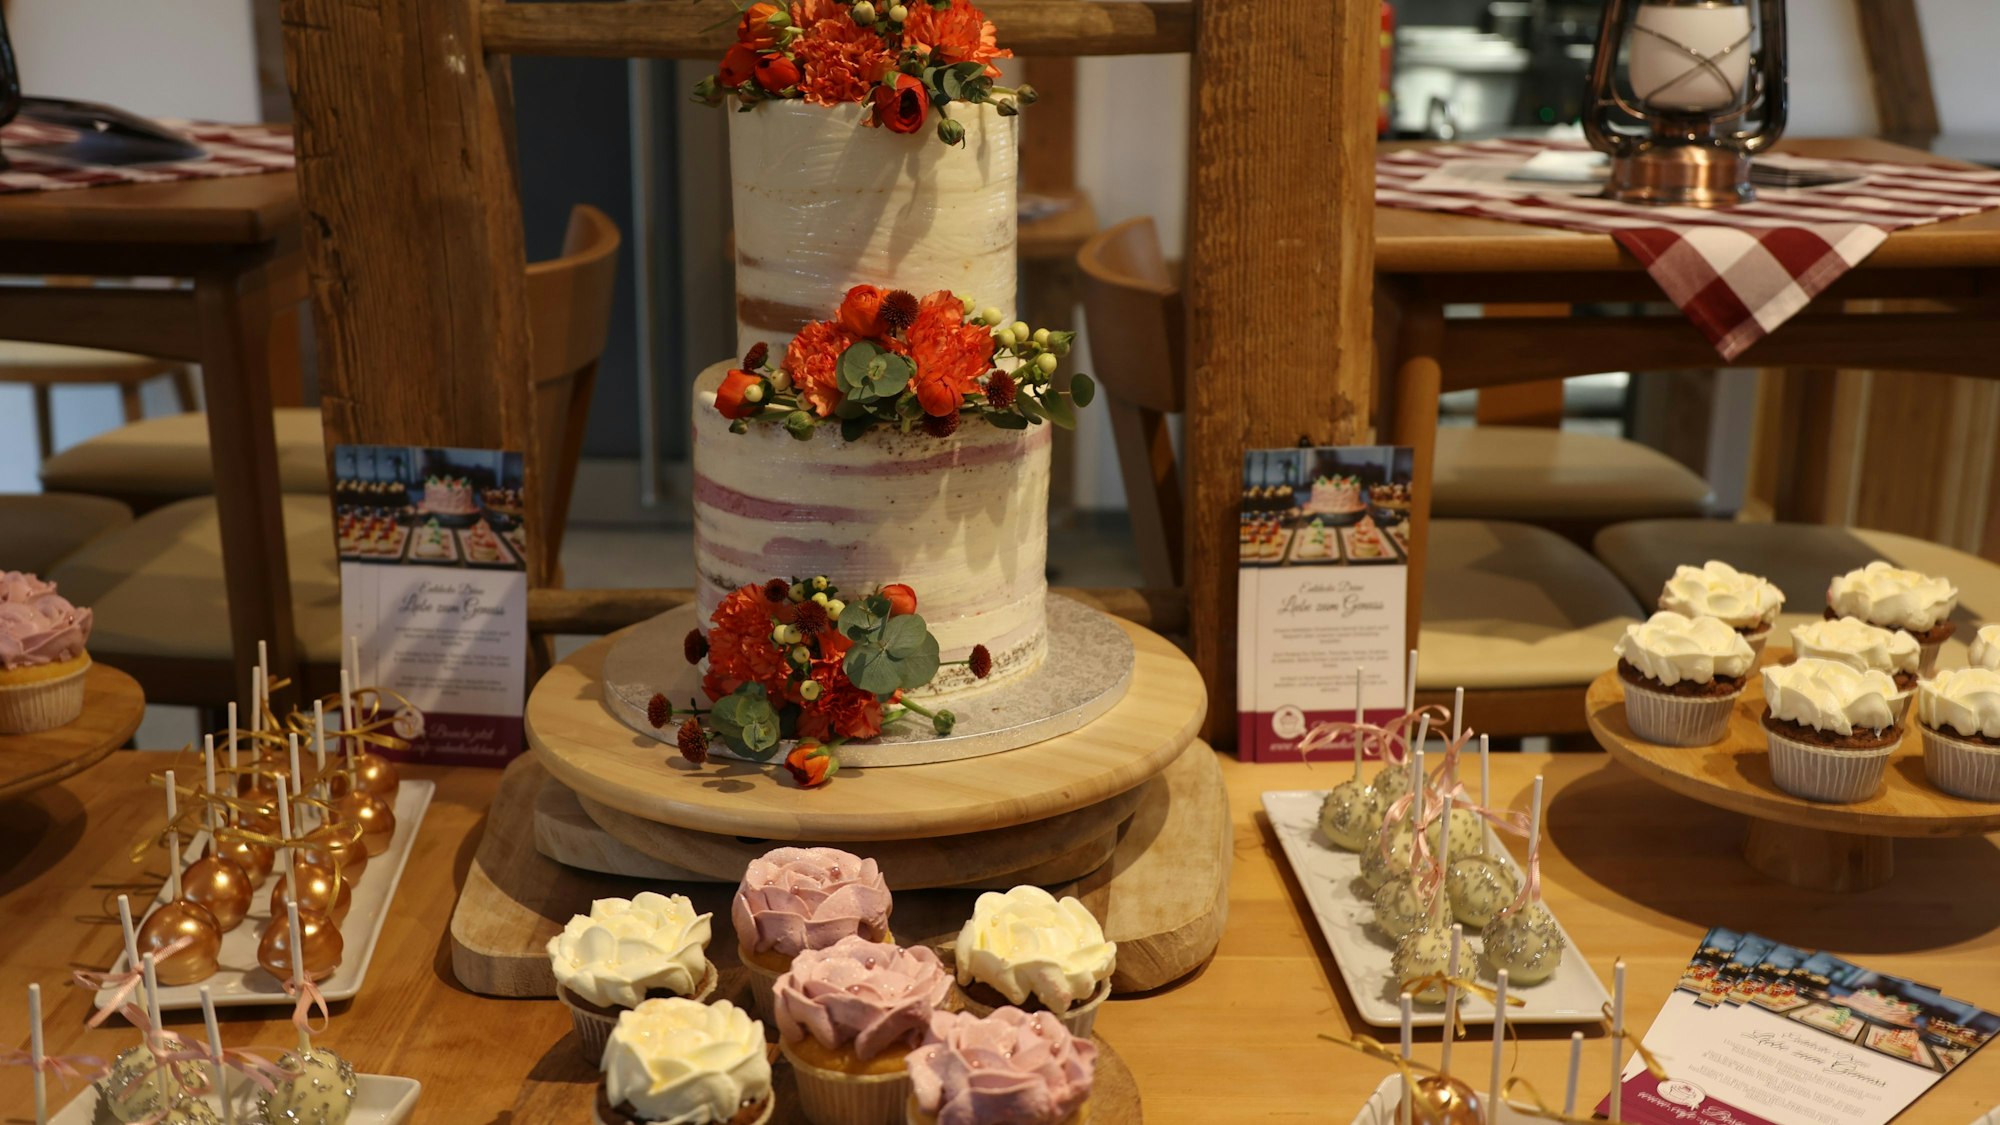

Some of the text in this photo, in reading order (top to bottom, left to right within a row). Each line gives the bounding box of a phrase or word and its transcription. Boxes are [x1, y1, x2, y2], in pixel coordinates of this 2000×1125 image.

[436, 604, 460, 613] zum
[461, 596, 505, 620] Genuss
[1315, 603, 1339, 612] zum
[1341, 593, 1385, 618] Genuss
